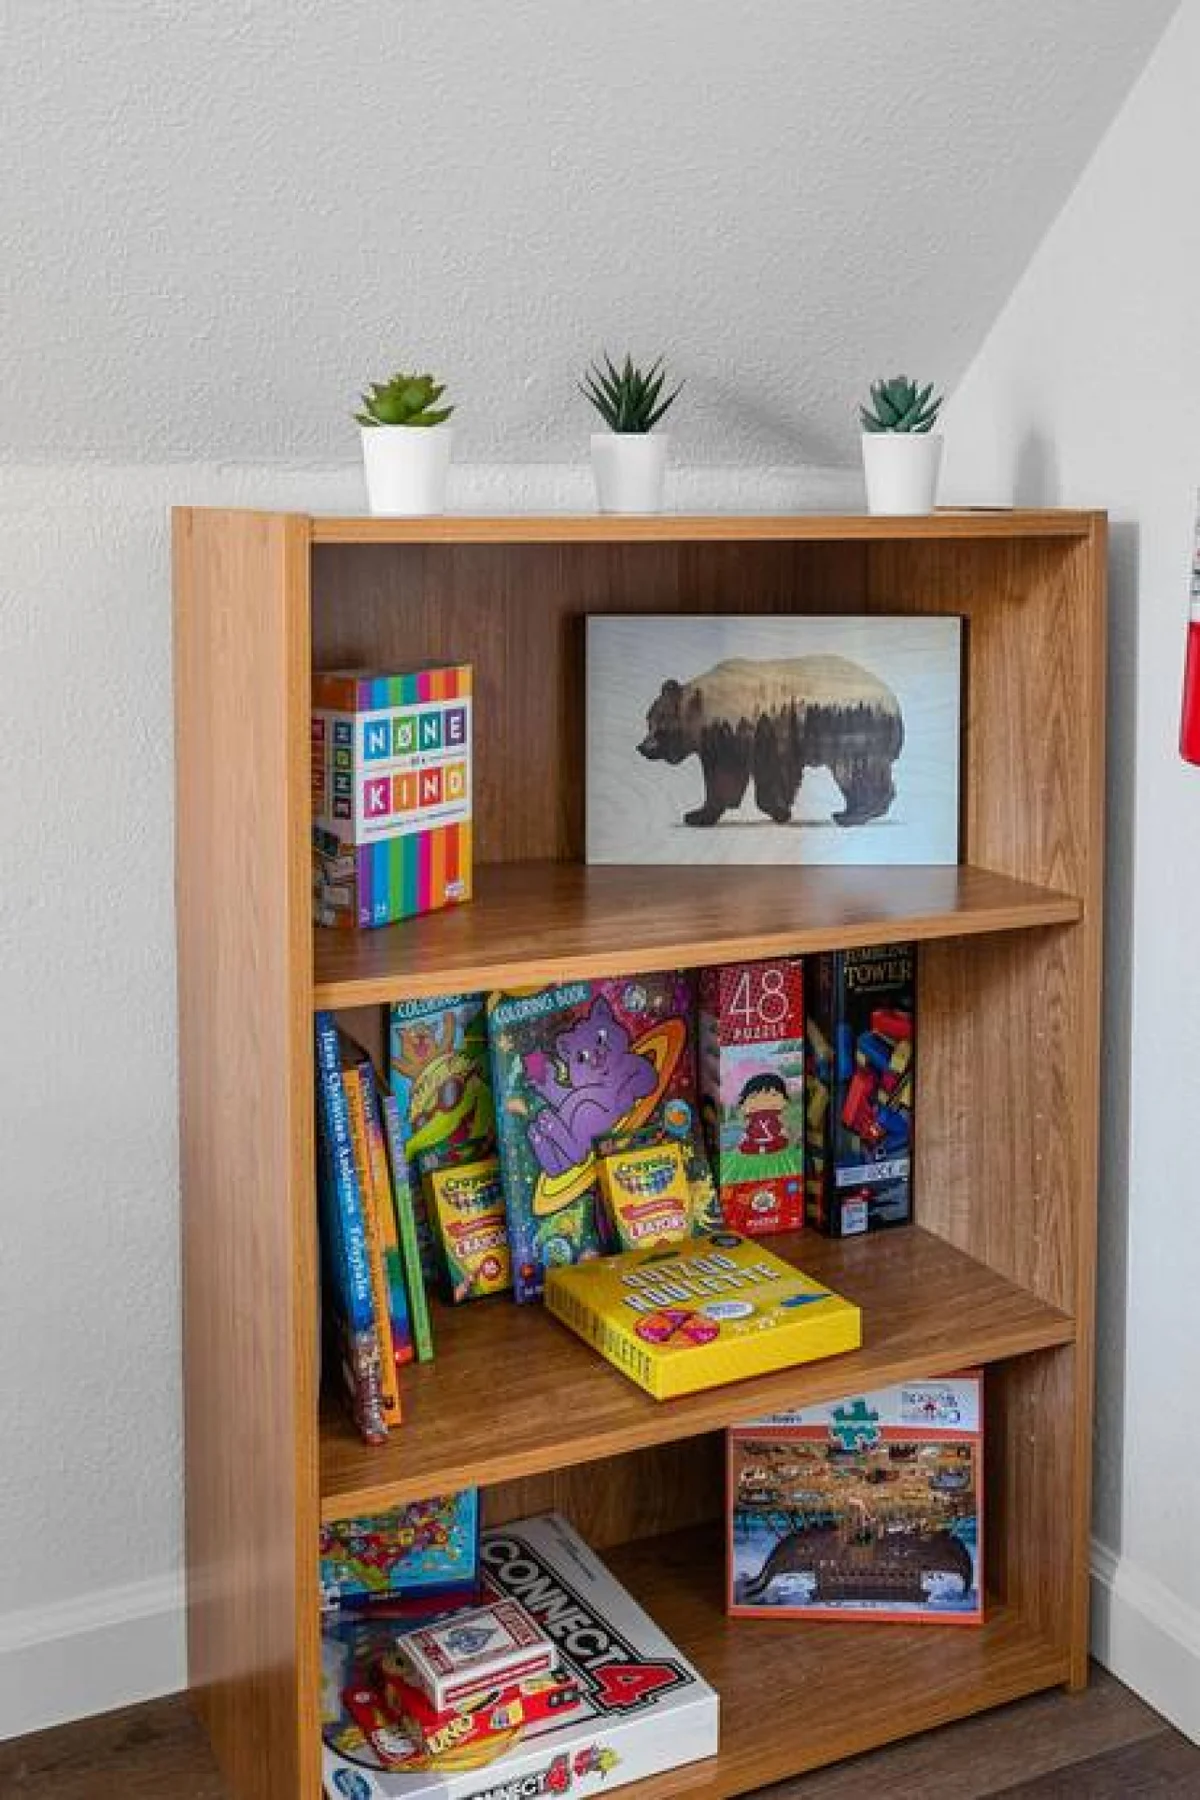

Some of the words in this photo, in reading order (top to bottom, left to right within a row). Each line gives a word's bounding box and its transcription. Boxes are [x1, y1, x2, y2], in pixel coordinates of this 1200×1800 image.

[371, 714, 462, 755] NONE
[370, 775, 463, 812] KIND
[843, 960, 913, 989] TOWER
[496, 993, 554, 1023] COLORING
[555, 985, 587, 1006] BOOK
[728, 969, 790, 1025] 48
[733, 1022, 787, 1040] PUZZLE
[630, 1214, 686, 1241] CRAYONS
[483, 1540, 632, 1669] CONNECT
[589, 1661, 687, 1711] 4
[427, 1715, 474, 1754] UNO
